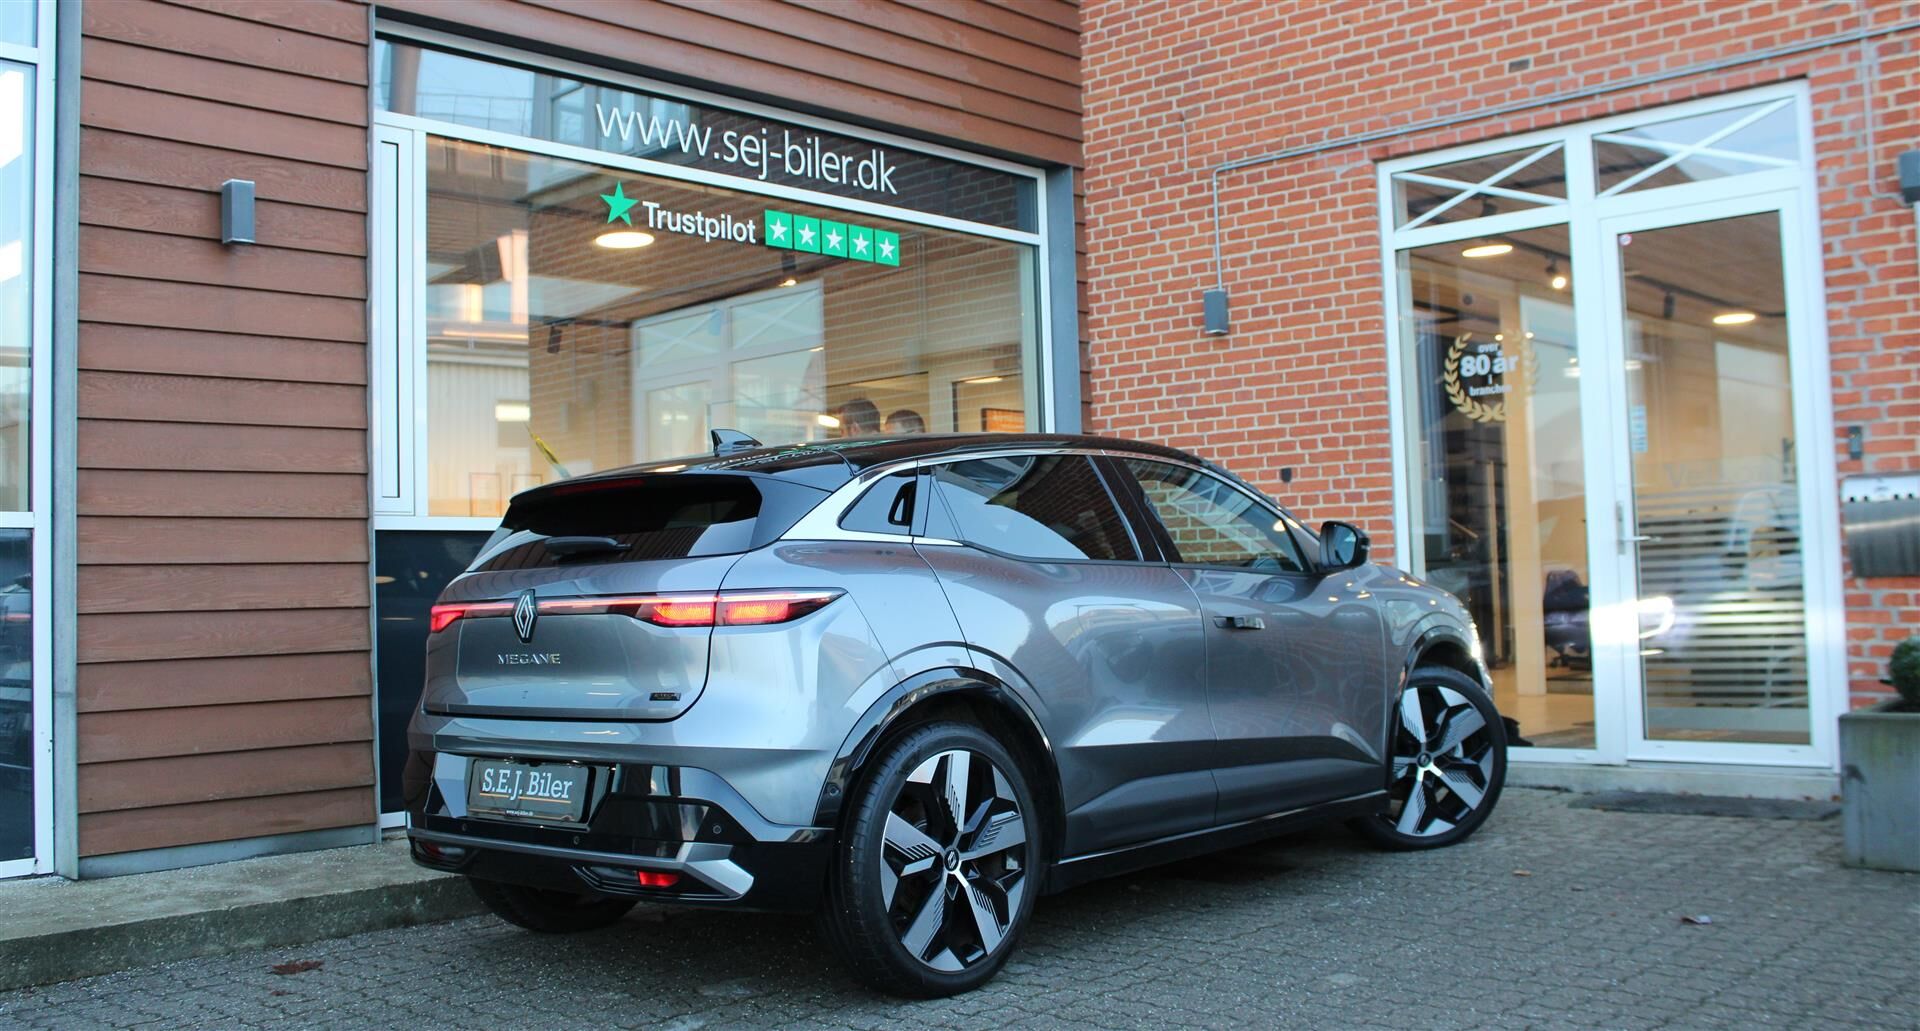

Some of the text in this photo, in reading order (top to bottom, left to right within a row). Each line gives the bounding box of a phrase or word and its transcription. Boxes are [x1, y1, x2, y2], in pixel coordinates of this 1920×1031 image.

[596, 103, 898, 195] www.sej-biler.dk
[641, 200, 757, 244] Trustpilot
[1478, 343, 1500, 353] over
[1460, 350, 1519, 377] 80 år
[497, 653, 561, 665] MEGANE
[482, 767, 573, 801] S.E.J. Biler
